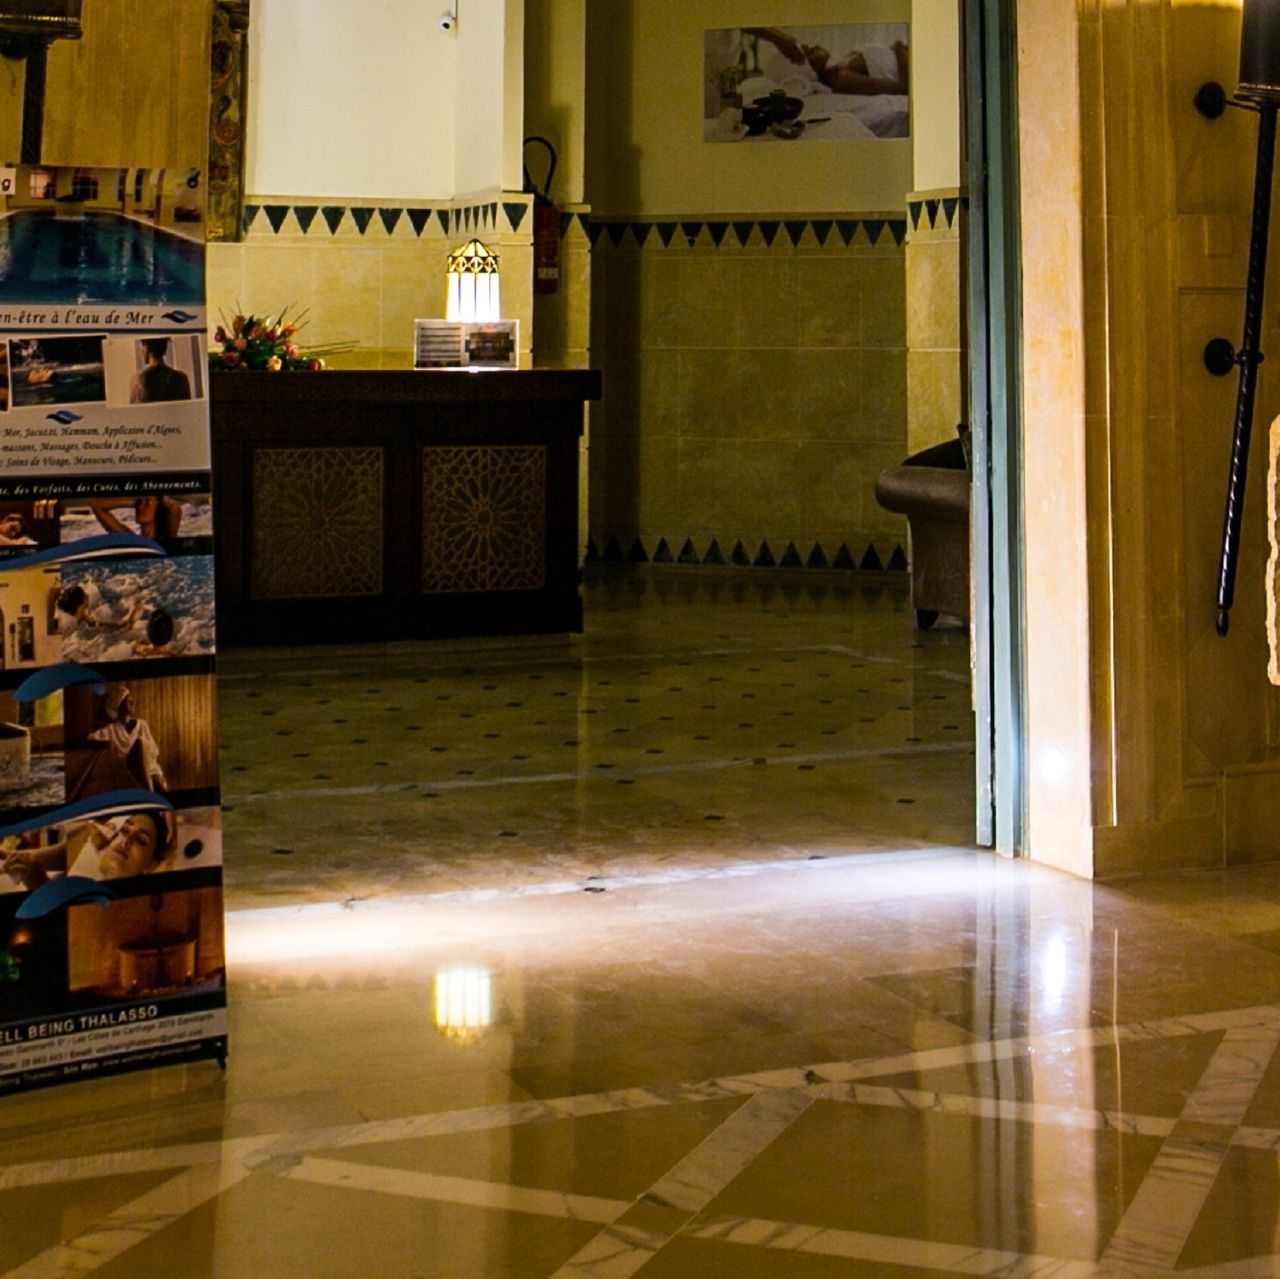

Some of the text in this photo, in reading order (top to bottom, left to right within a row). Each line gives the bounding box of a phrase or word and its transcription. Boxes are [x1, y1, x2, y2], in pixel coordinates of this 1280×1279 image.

[51, 311, 59, 324] à
[65, 310, 99, 324] l'eau
[105, 311, 120, 324] de
[125, 311, 154, 325] Mer
[28, 1020, 74, 1039] BEING
[80, 1005, 158, 1030] THALASSO
